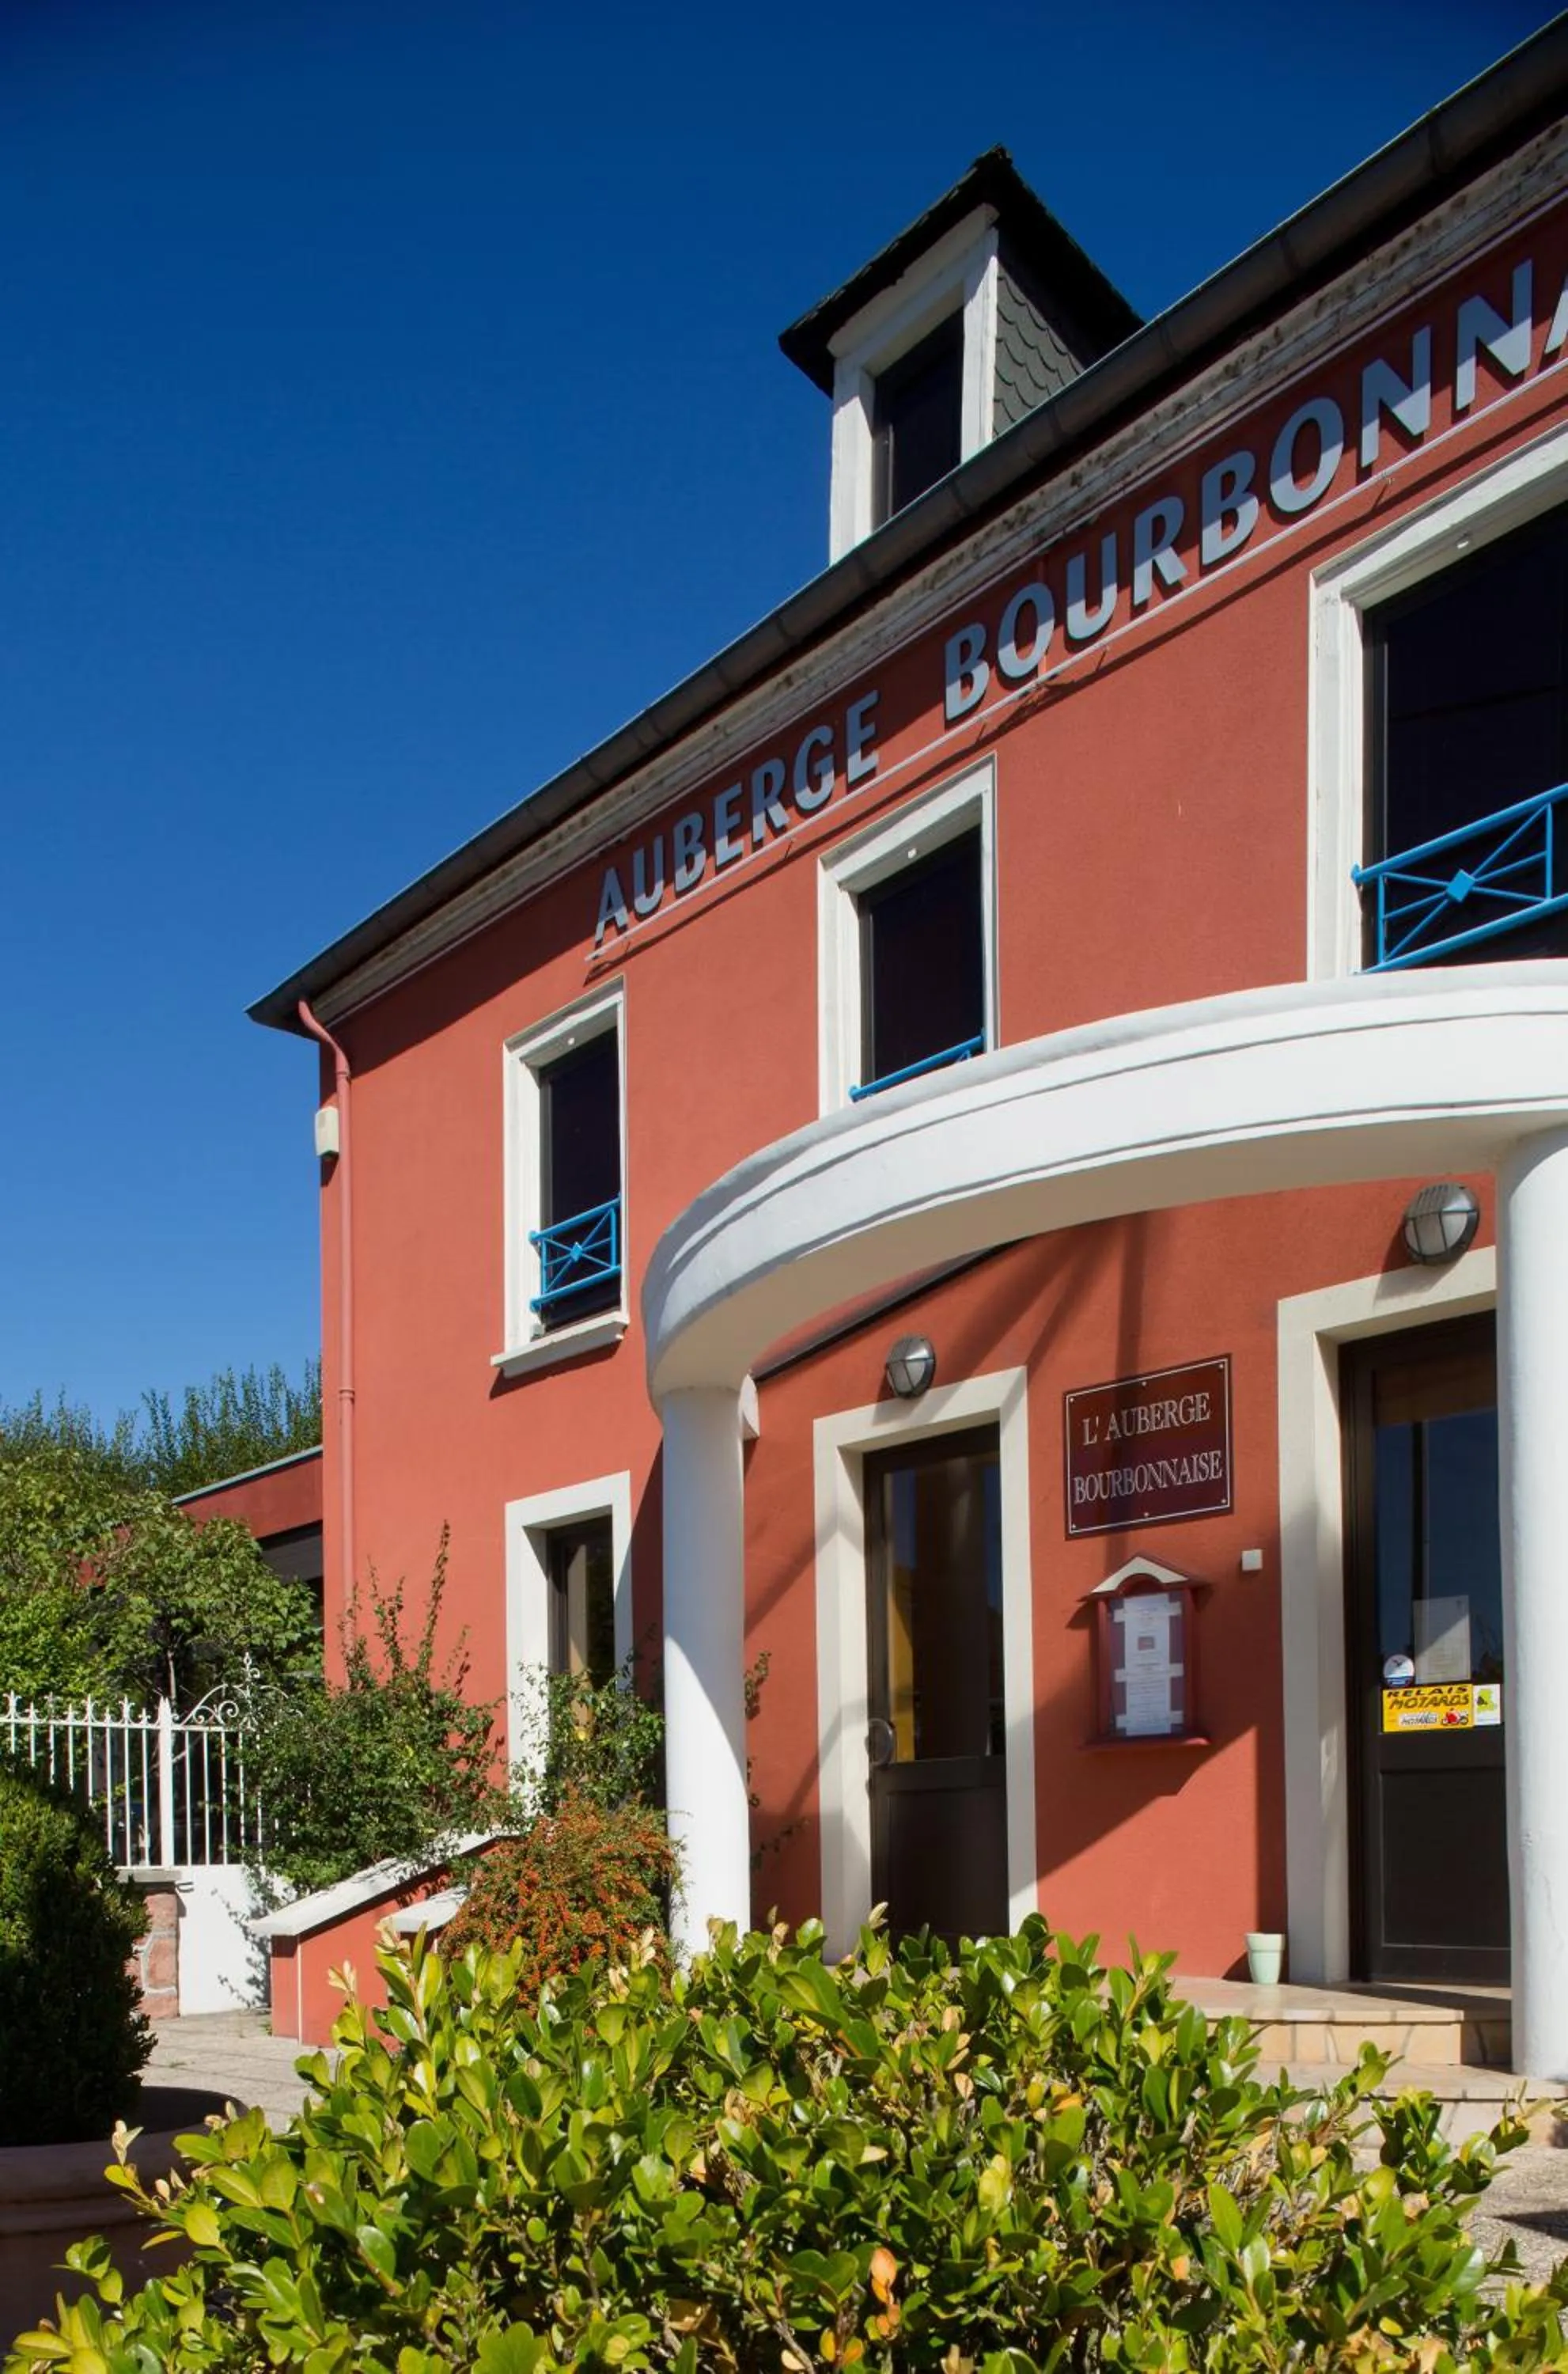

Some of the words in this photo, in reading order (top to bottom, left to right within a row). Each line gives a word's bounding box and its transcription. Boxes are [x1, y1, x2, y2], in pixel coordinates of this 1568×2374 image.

[594, 690, 879, 942] AUBERGE
[1074, 1450, 1223, 1504] BOURBONNAISE
[1387, 1686, 1468, 1697] RELAIS
[1389, 1694, 1469, 1710] MOTARDS
